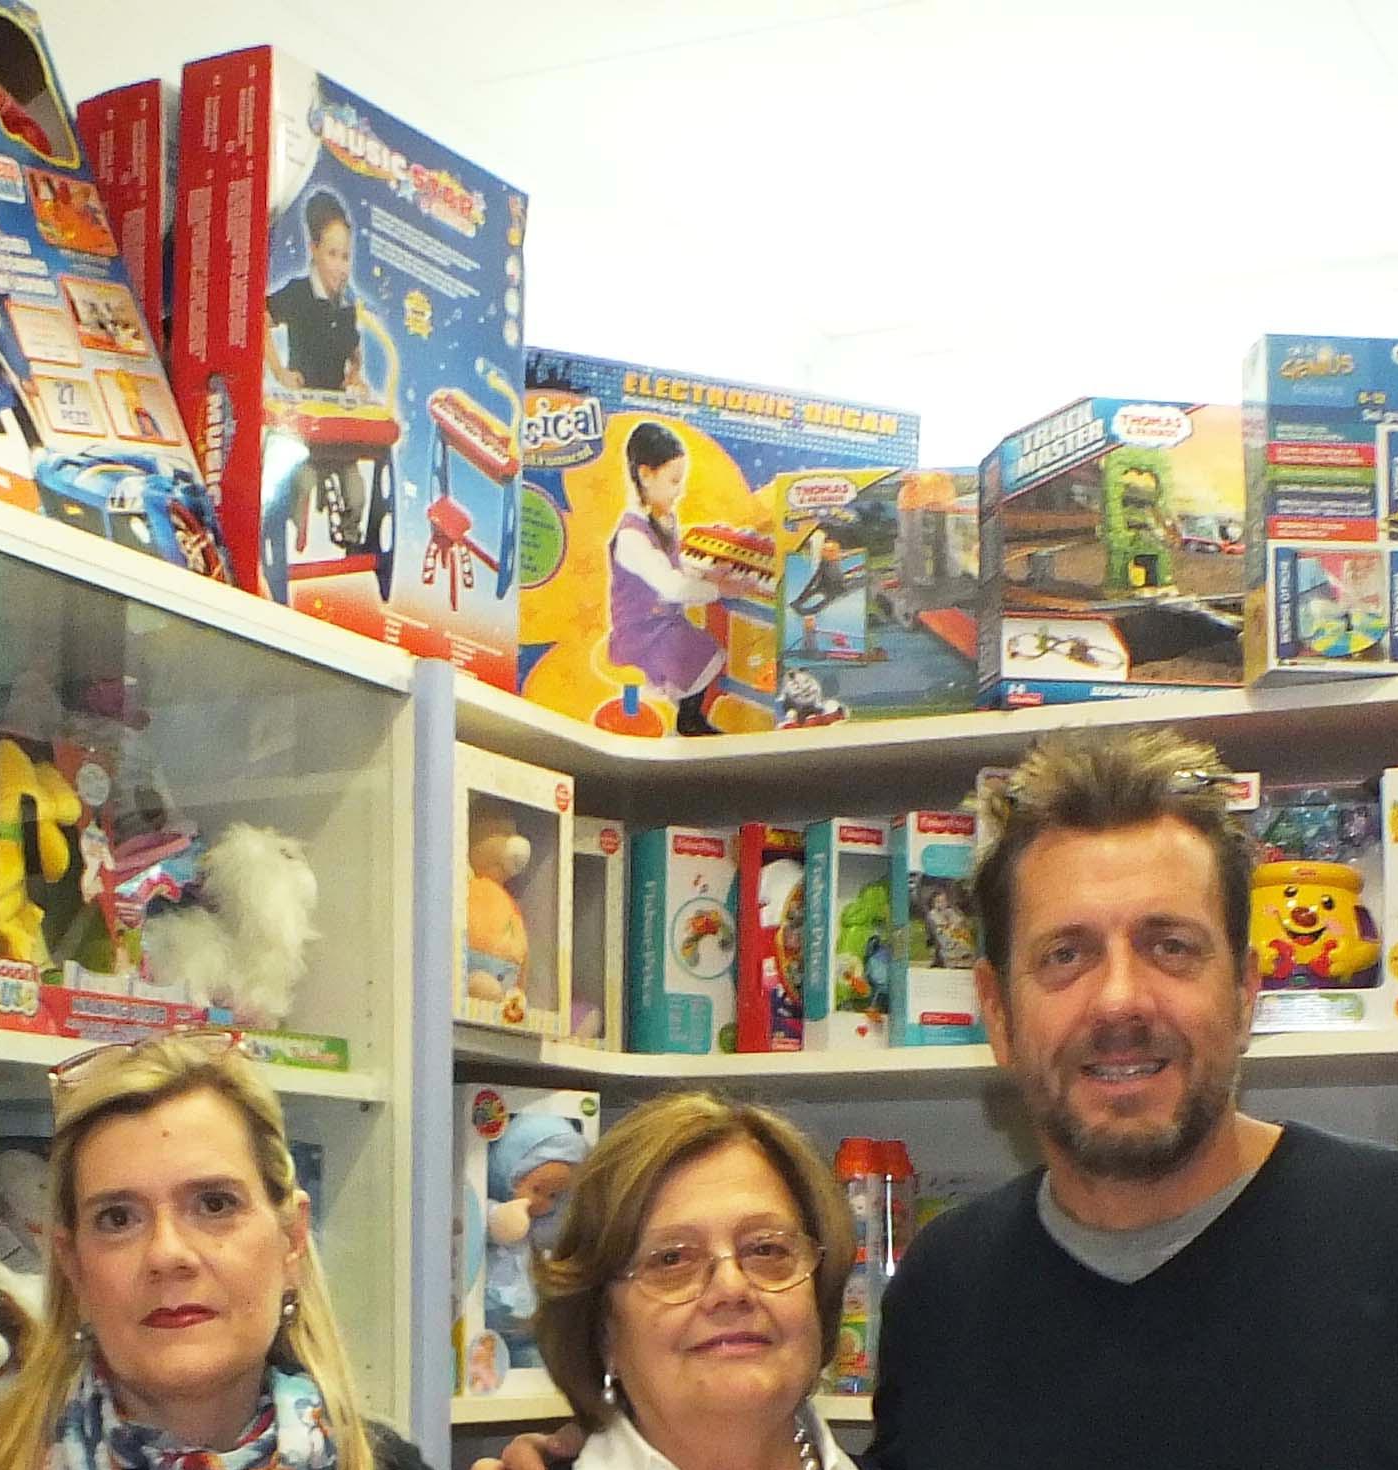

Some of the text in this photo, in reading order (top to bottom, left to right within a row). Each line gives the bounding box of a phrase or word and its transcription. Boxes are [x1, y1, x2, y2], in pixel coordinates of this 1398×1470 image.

[322, 112, 407, 173] MUSIC
[523, 397, 601, 446] sical
[623, 372, 899, 435] ELECTRONIC ORGAN
